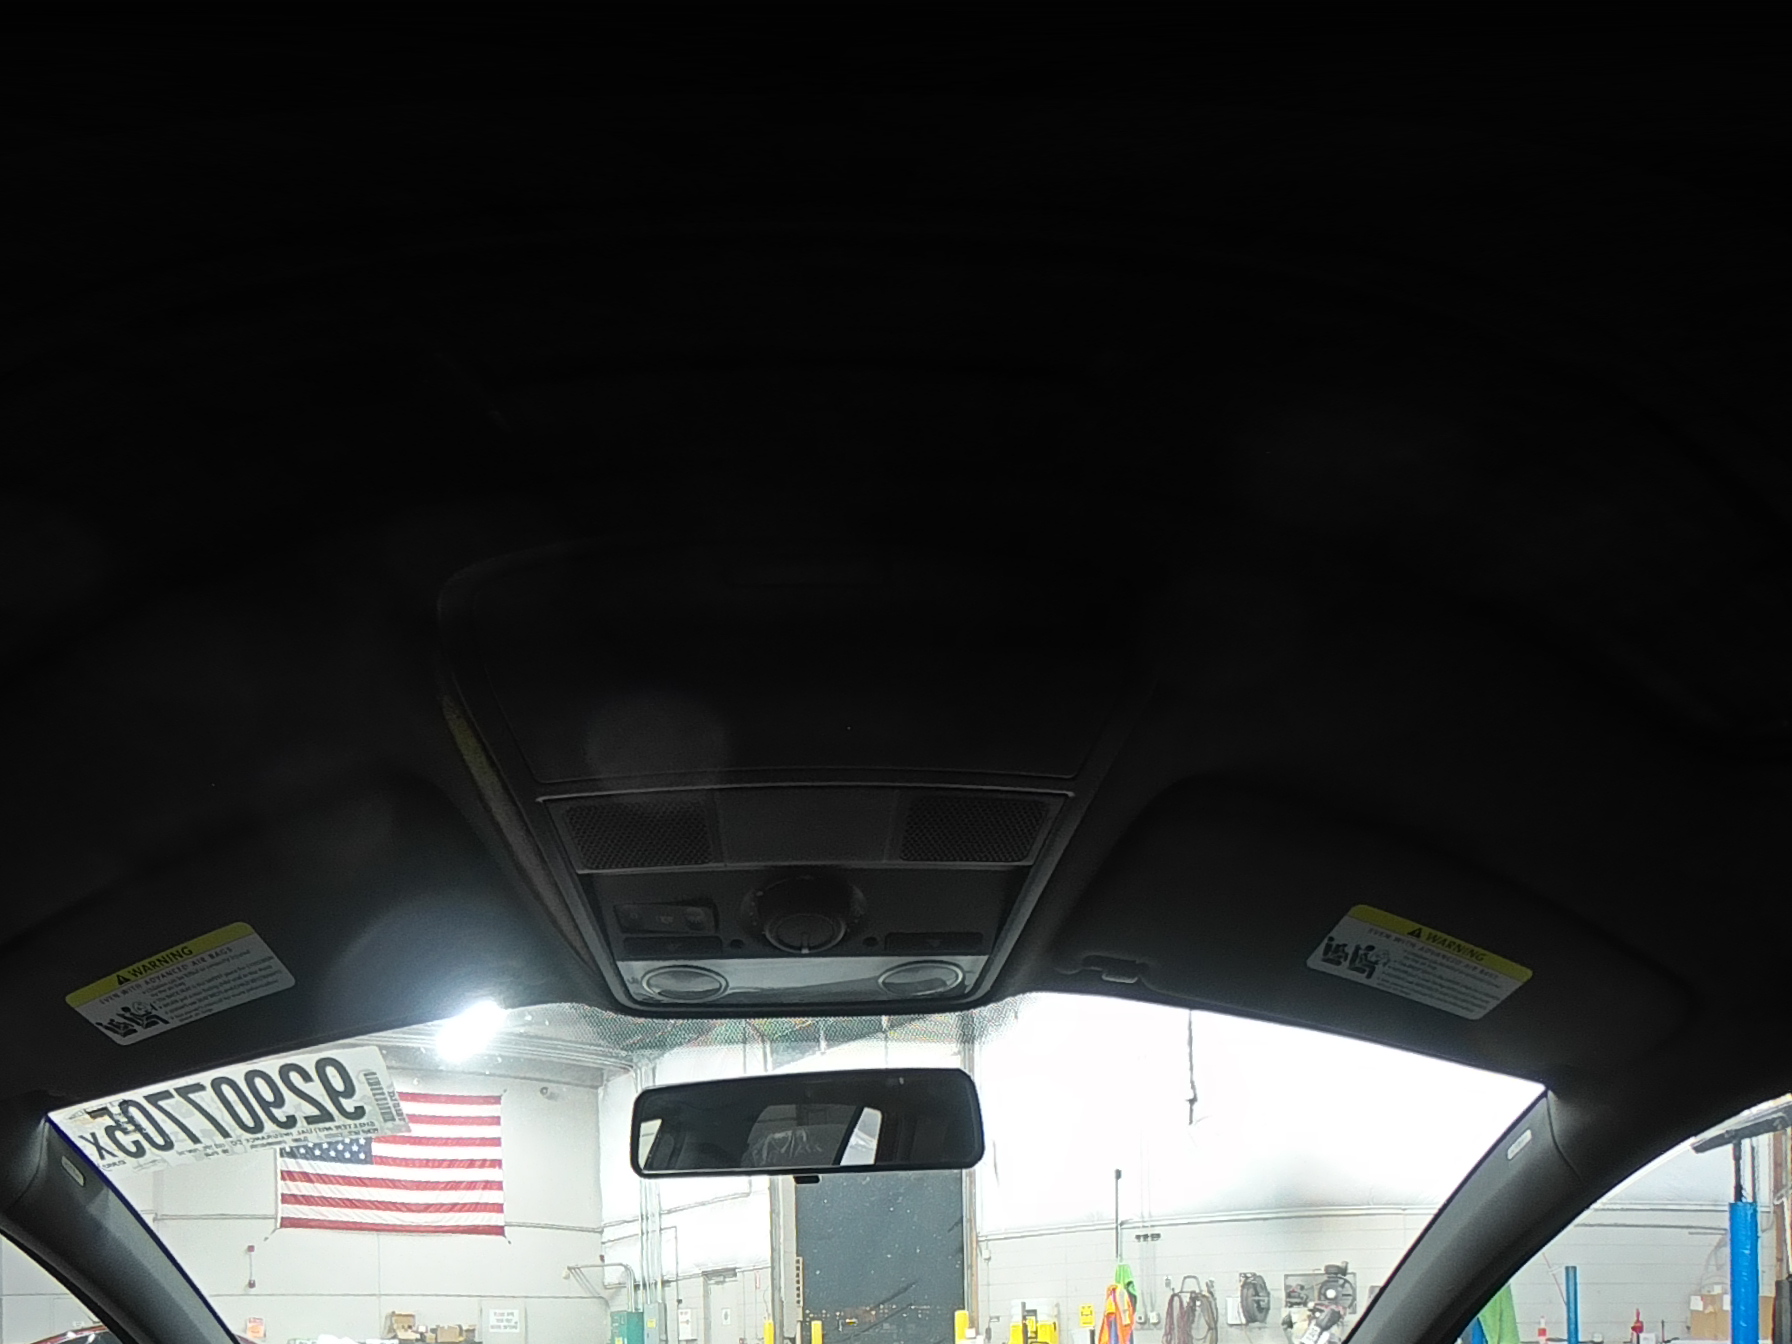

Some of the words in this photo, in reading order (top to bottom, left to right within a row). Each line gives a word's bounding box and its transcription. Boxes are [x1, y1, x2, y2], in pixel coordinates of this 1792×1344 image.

[127, 946, 193, 978] WARNING
[1425, 931, 1487, 962] WARNING
[99, 991, 121, 1005] EVEN
[121, 983, 143, 997] WITH
[144, 964, 188, 986] ADVANCED
[191, 956, 207, 967] AIR
[208, 947, 233, 960] BAGS
